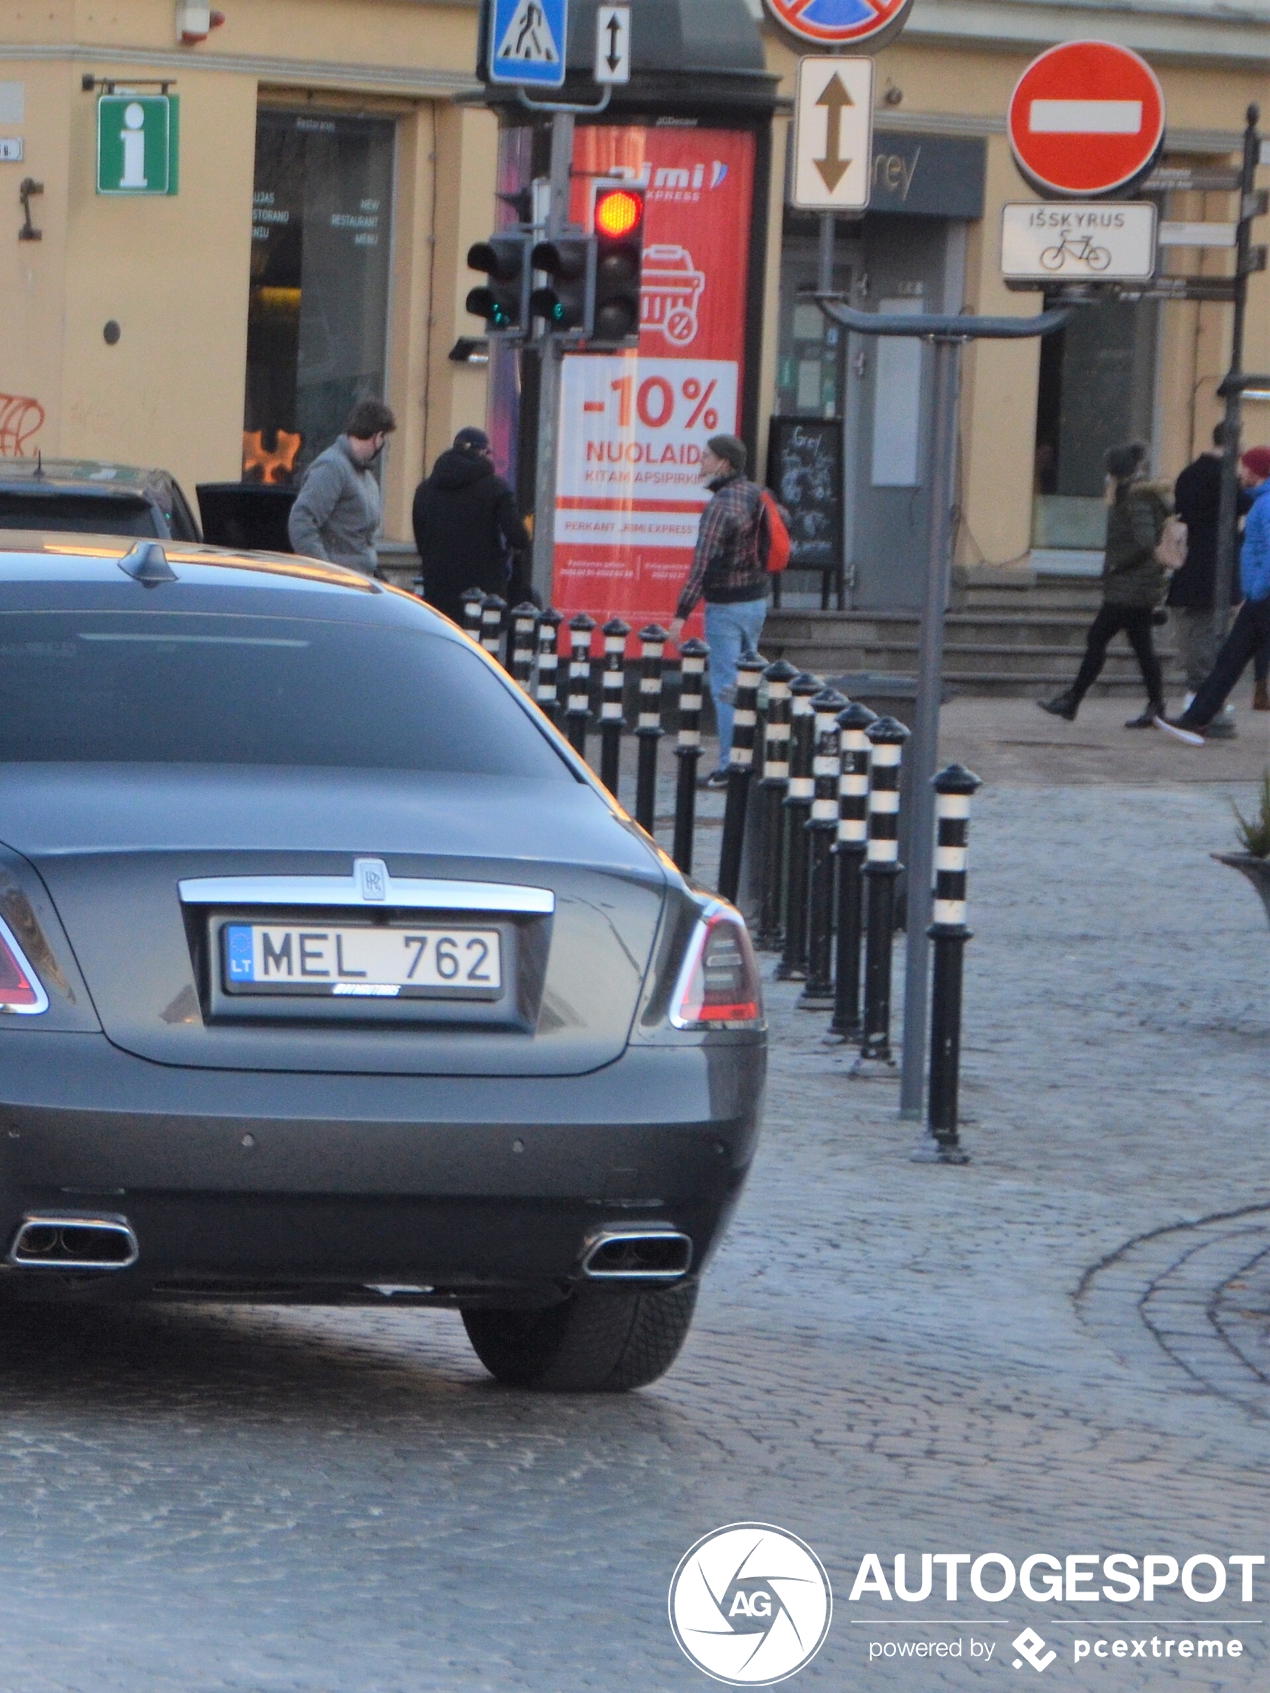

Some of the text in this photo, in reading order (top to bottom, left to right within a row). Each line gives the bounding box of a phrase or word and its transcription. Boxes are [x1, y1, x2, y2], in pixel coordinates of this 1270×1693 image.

[873, 146, 922, 201] rey
[253, 192, 275, 204] UJAS
[645, 190, 701, 202] XPRESS
[252, 209, 289, 222] STORANO
[1030, 209, 1125, 228] IŠSKYRUS
[252, 226, 270, 239] NIU
[584, 375, 718, 430] -10%
[586, 441, 702, 465] NUOLAID
[262, 933, 490, 981] MEL 762
[231, 959, 252, 973] LT
